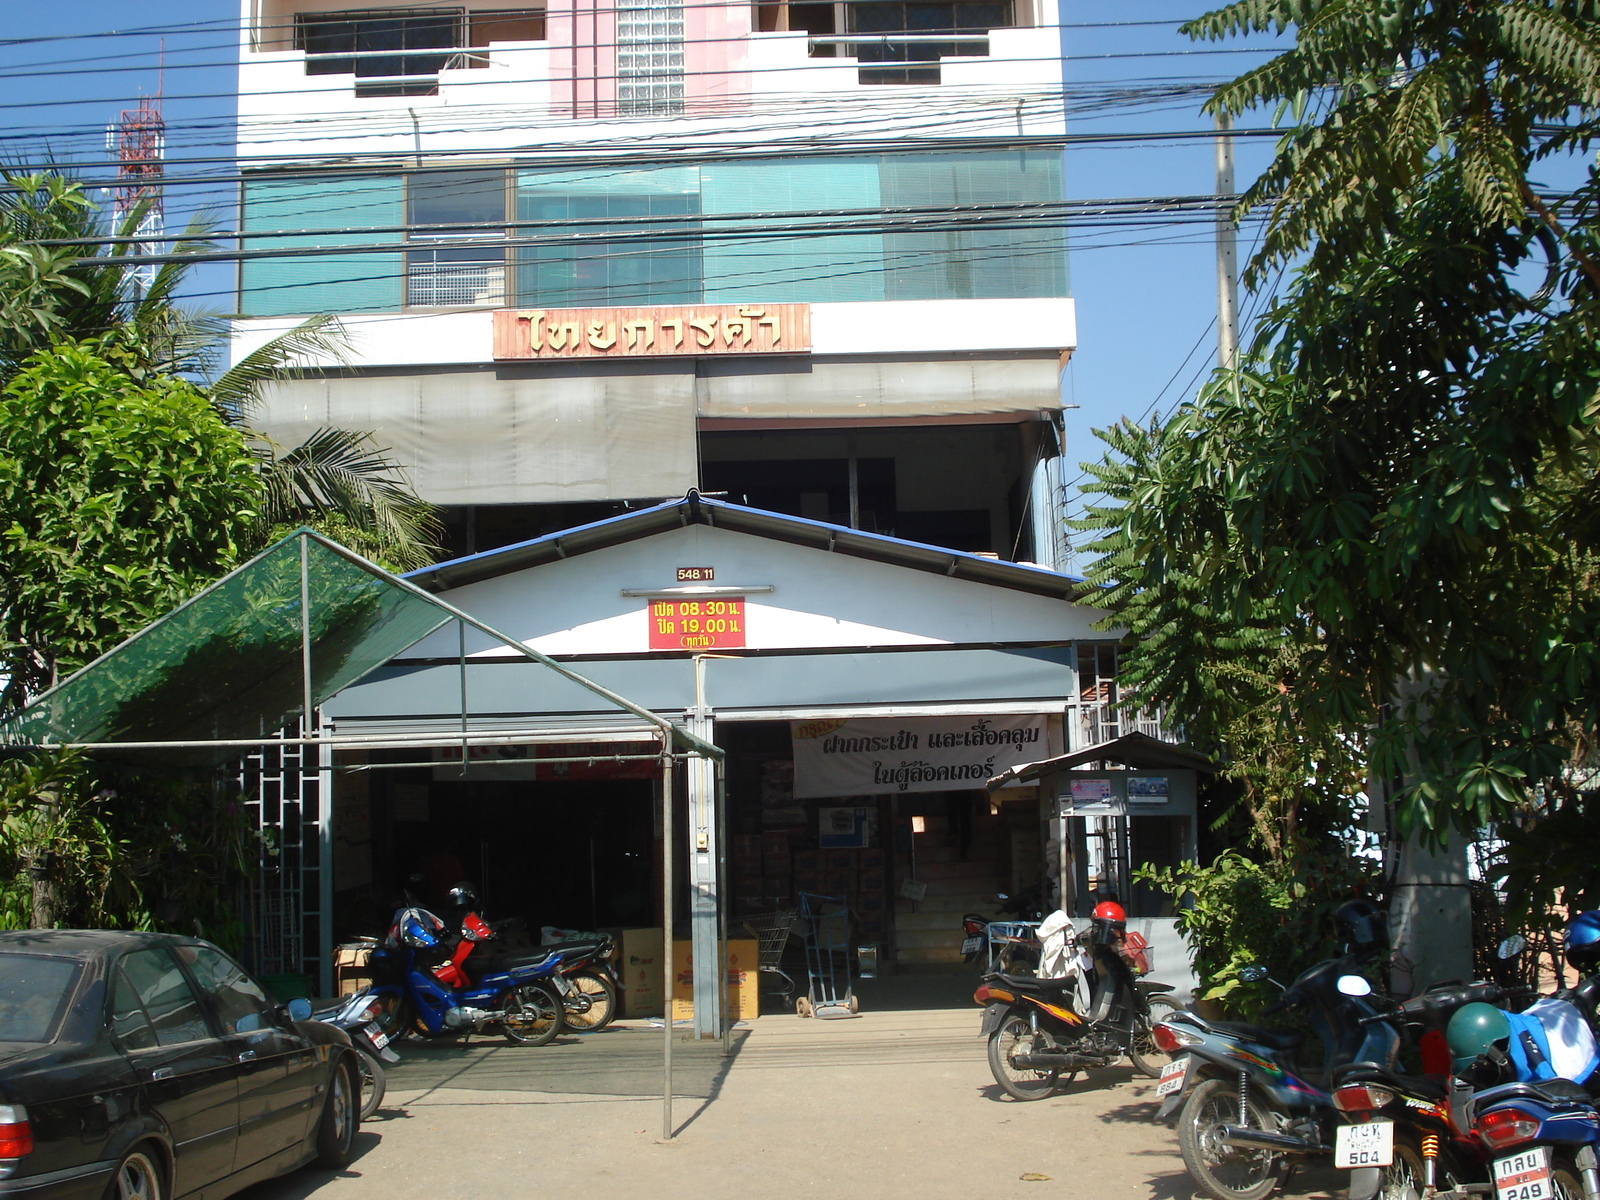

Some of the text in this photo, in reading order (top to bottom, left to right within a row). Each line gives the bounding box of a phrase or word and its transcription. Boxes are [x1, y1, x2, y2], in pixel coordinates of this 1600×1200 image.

[518, 305, 782, 352] ไทยการค้า
[654, 601, 740, 616] เปิด 08.30 น.
[657, 618, 741, 634] ปิด 19.00 น.
[823, 719, 1040, 754] ฝากกระเป๋า และเสื้อคลุม
[1349, 1151, 1379, 1165] 504
[1502, 1153, 1537, 1175] กลย
[1507, 1183, 1543, 1200] 249
